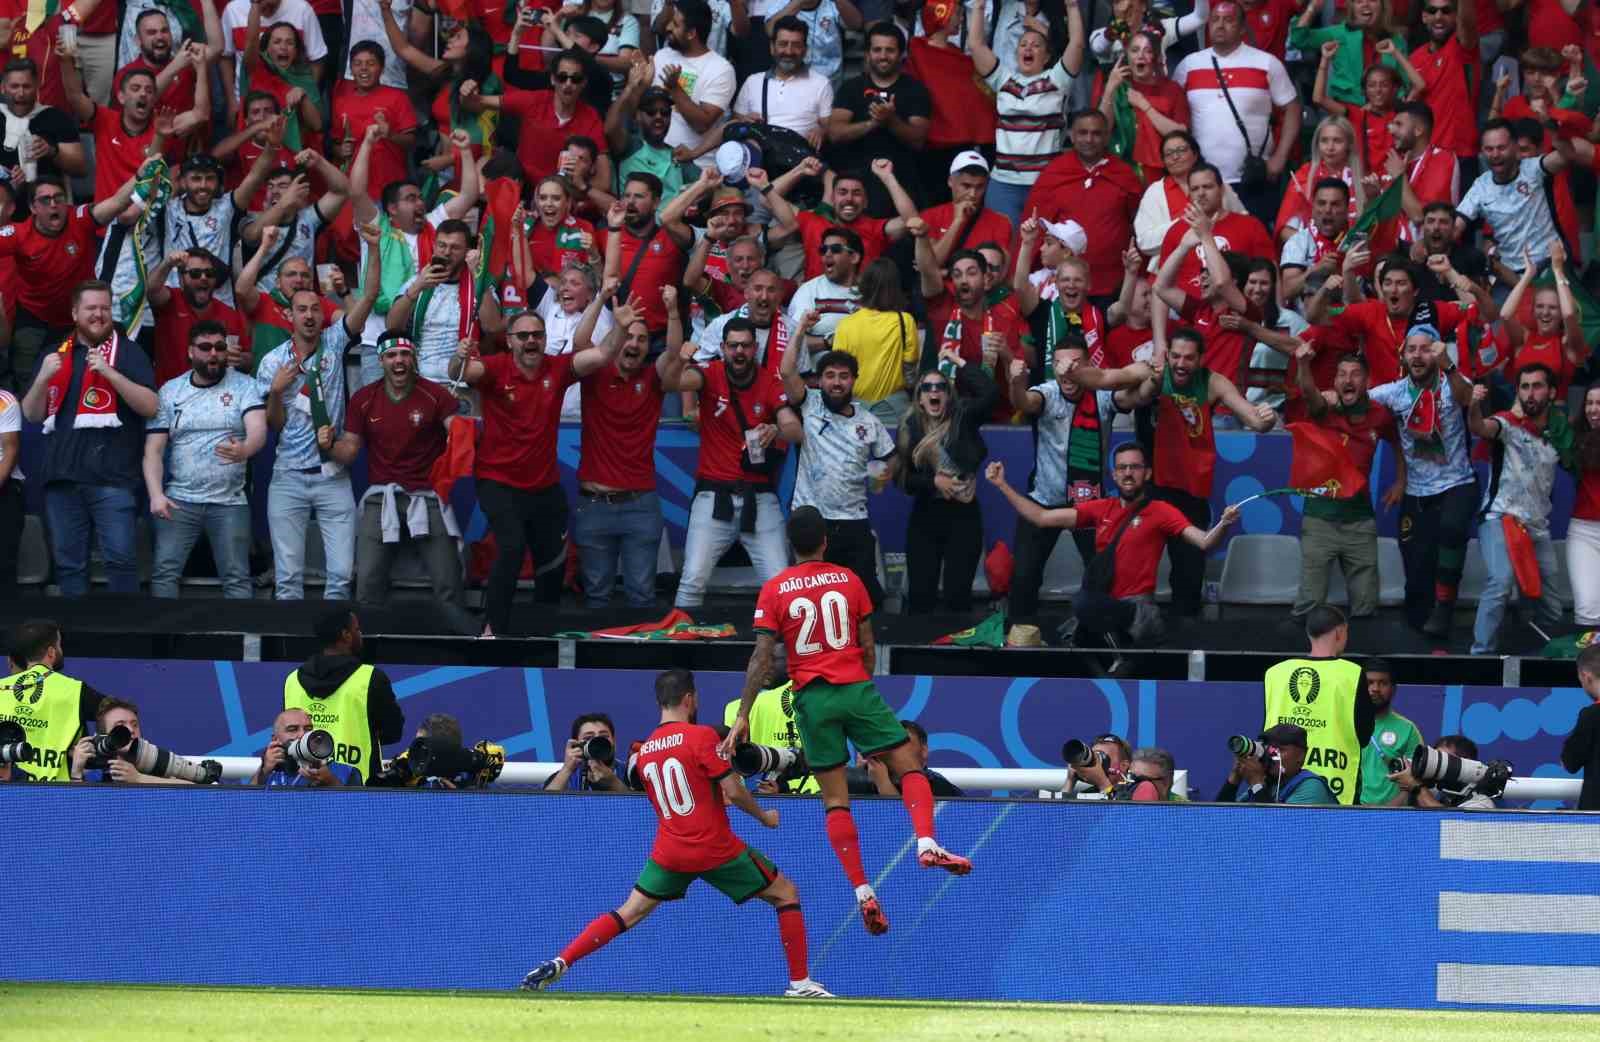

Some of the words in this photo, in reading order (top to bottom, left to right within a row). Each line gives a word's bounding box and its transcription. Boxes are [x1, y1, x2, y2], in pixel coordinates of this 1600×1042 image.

[174, 409, 183, 429] 7
[819, 417, 832, 435] 7
[779, 577, 803, 594] JOÃO
[804, 572, 849, 588] CANCELO
[788, 590, 850, 656] 20
[1278, 716, 1327, 729] EURO2024
[640, 732, 684, 757] BERNARDO
[643, 756, 696, 820] 10
